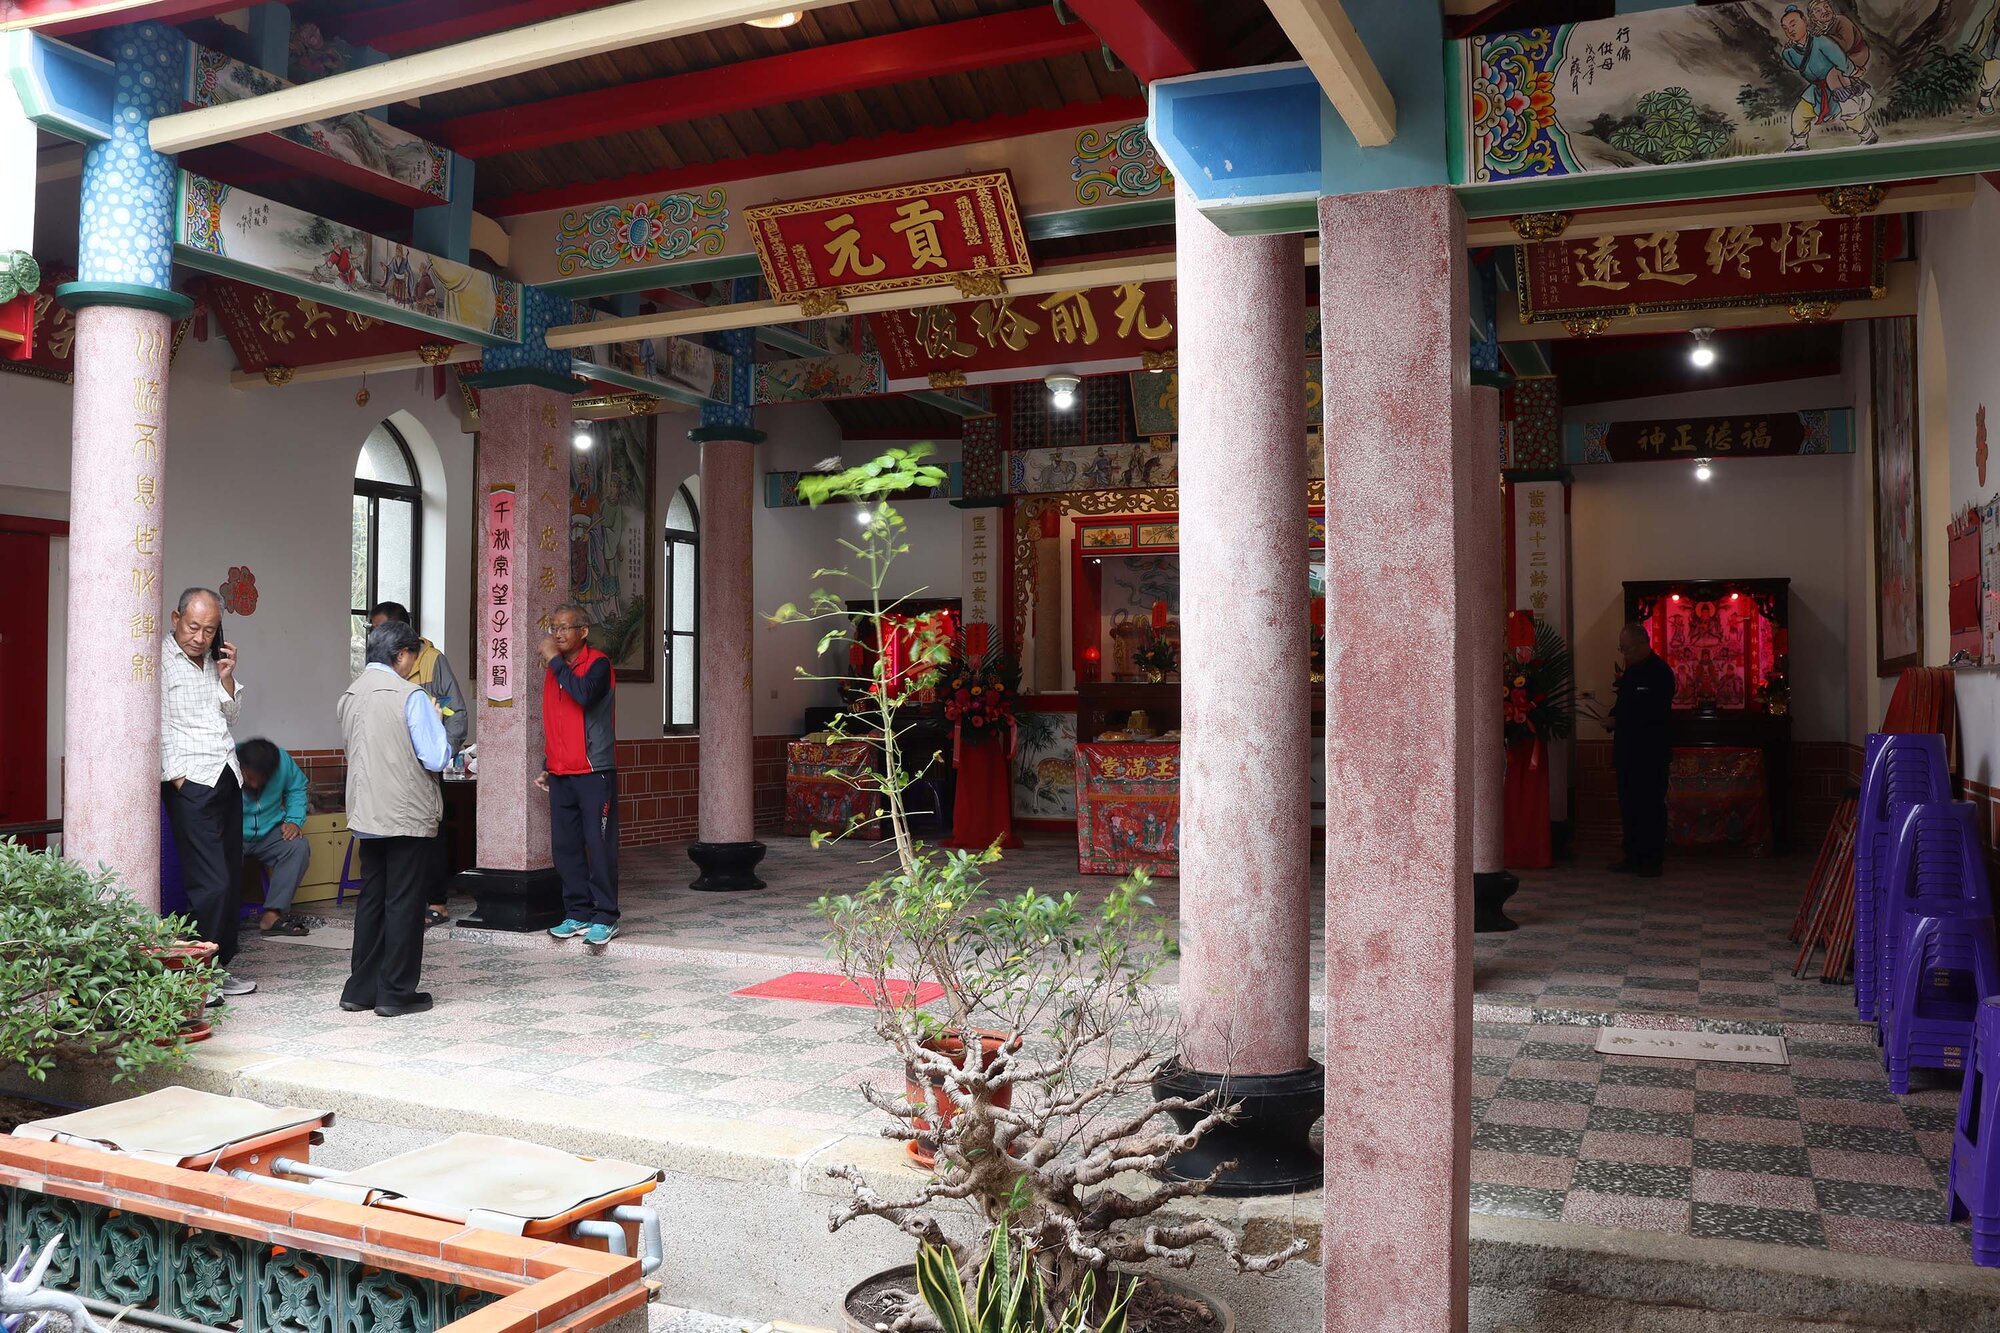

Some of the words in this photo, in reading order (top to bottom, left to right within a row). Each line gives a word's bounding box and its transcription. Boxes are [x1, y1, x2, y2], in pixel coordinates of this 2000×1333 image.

[823, 199, 949, 279] 貢元
[1637, 420, 1772, 455] 福德正神
